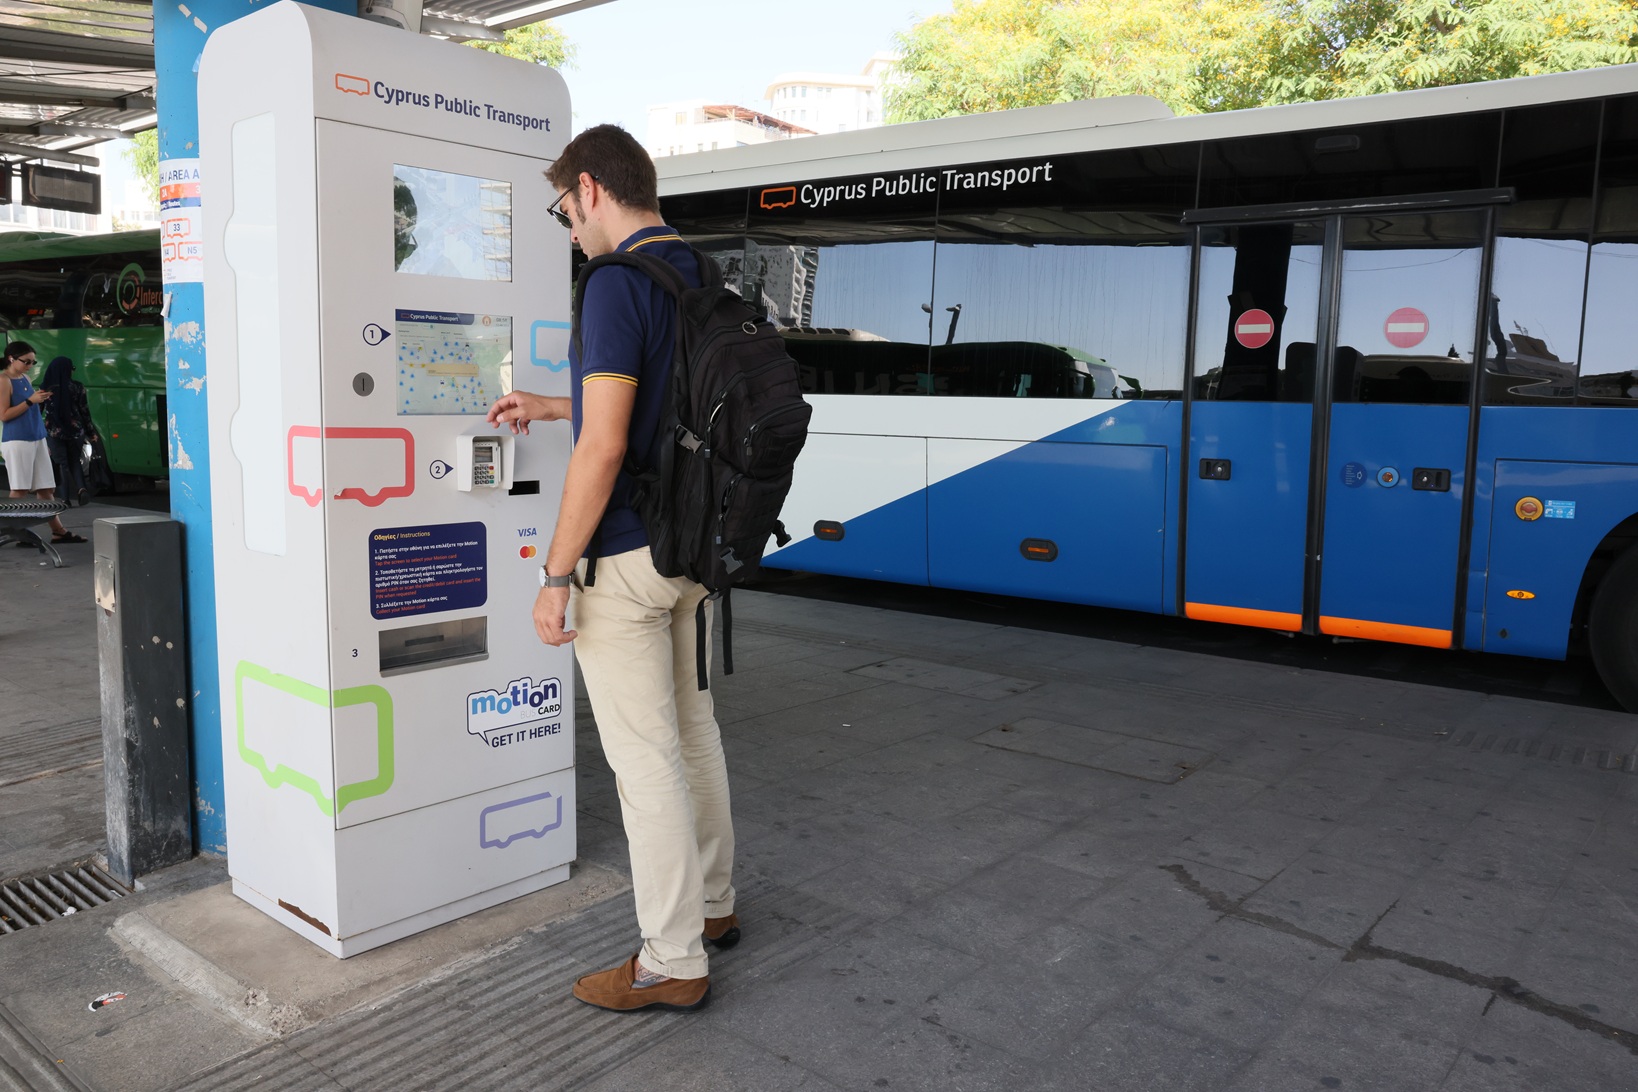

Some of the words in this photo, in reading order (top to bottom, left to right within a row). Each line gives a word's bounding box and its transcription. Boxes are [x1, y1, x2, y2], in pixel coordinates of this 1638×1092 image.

[373, 80, 430, 108] Cyprus
[434, 93, 480, 118] Public
[484, 104, 550, 132] Transport
[168, 169, 190, 181] AREA
[192, 168, 200, 179] A
[800, 182, 866, 208] Cyprus
[872, 172, 936, 198] Public
[942, 162, 1053, 190] Transport
[173, 223, 180, 232] 33
[370, 330, 374, 338] 1
[517, 528, 537, 537] VISA
[352, 648, 358, 658] 3
[472, 682, 558, 715] motion
[538, 704, 560, 715] CARD
[492, 733, 513, 748] GET
[517, 730, 526, 742] IT
[530, 722, 560, 739] HERE!
